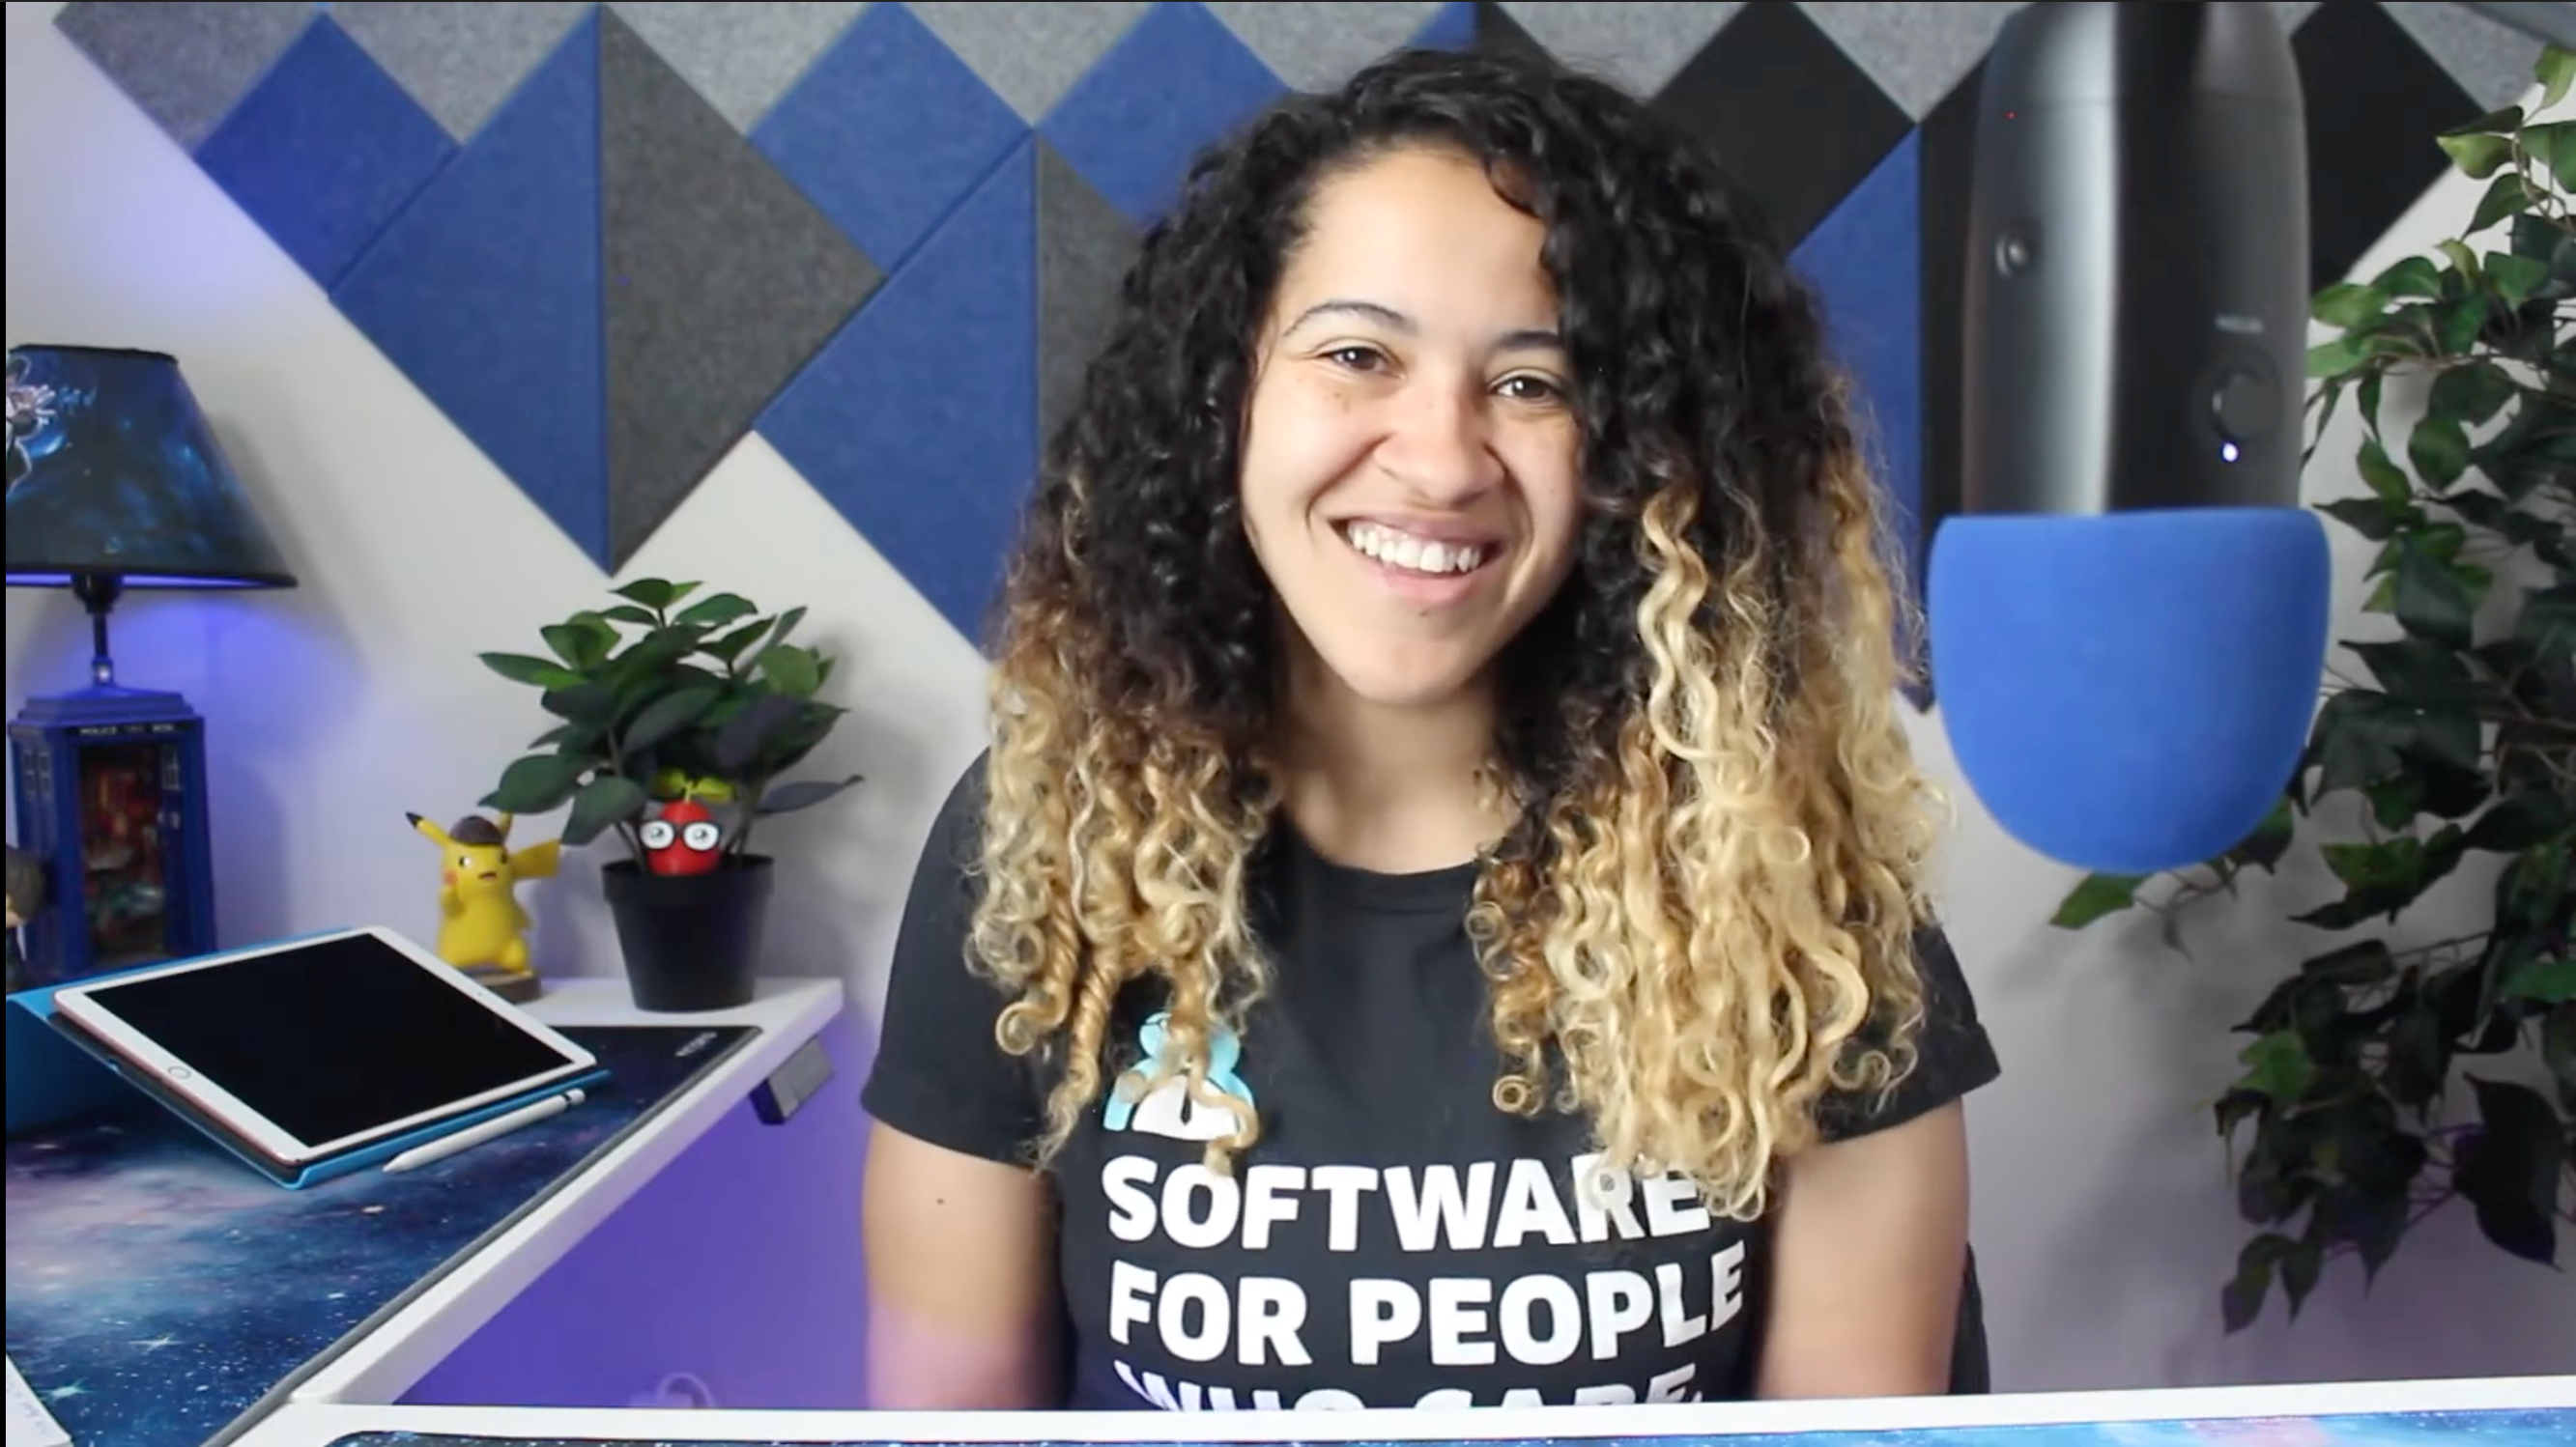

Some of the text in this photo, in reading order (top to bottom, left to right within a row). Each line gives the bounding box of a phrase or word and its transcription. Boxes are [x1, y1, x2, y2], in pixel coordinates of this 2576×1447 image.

[1102, 1154, 1710, 1252] SOFTWARE
[1109, 1239, 1746, 1366] FOR PEOPLE
